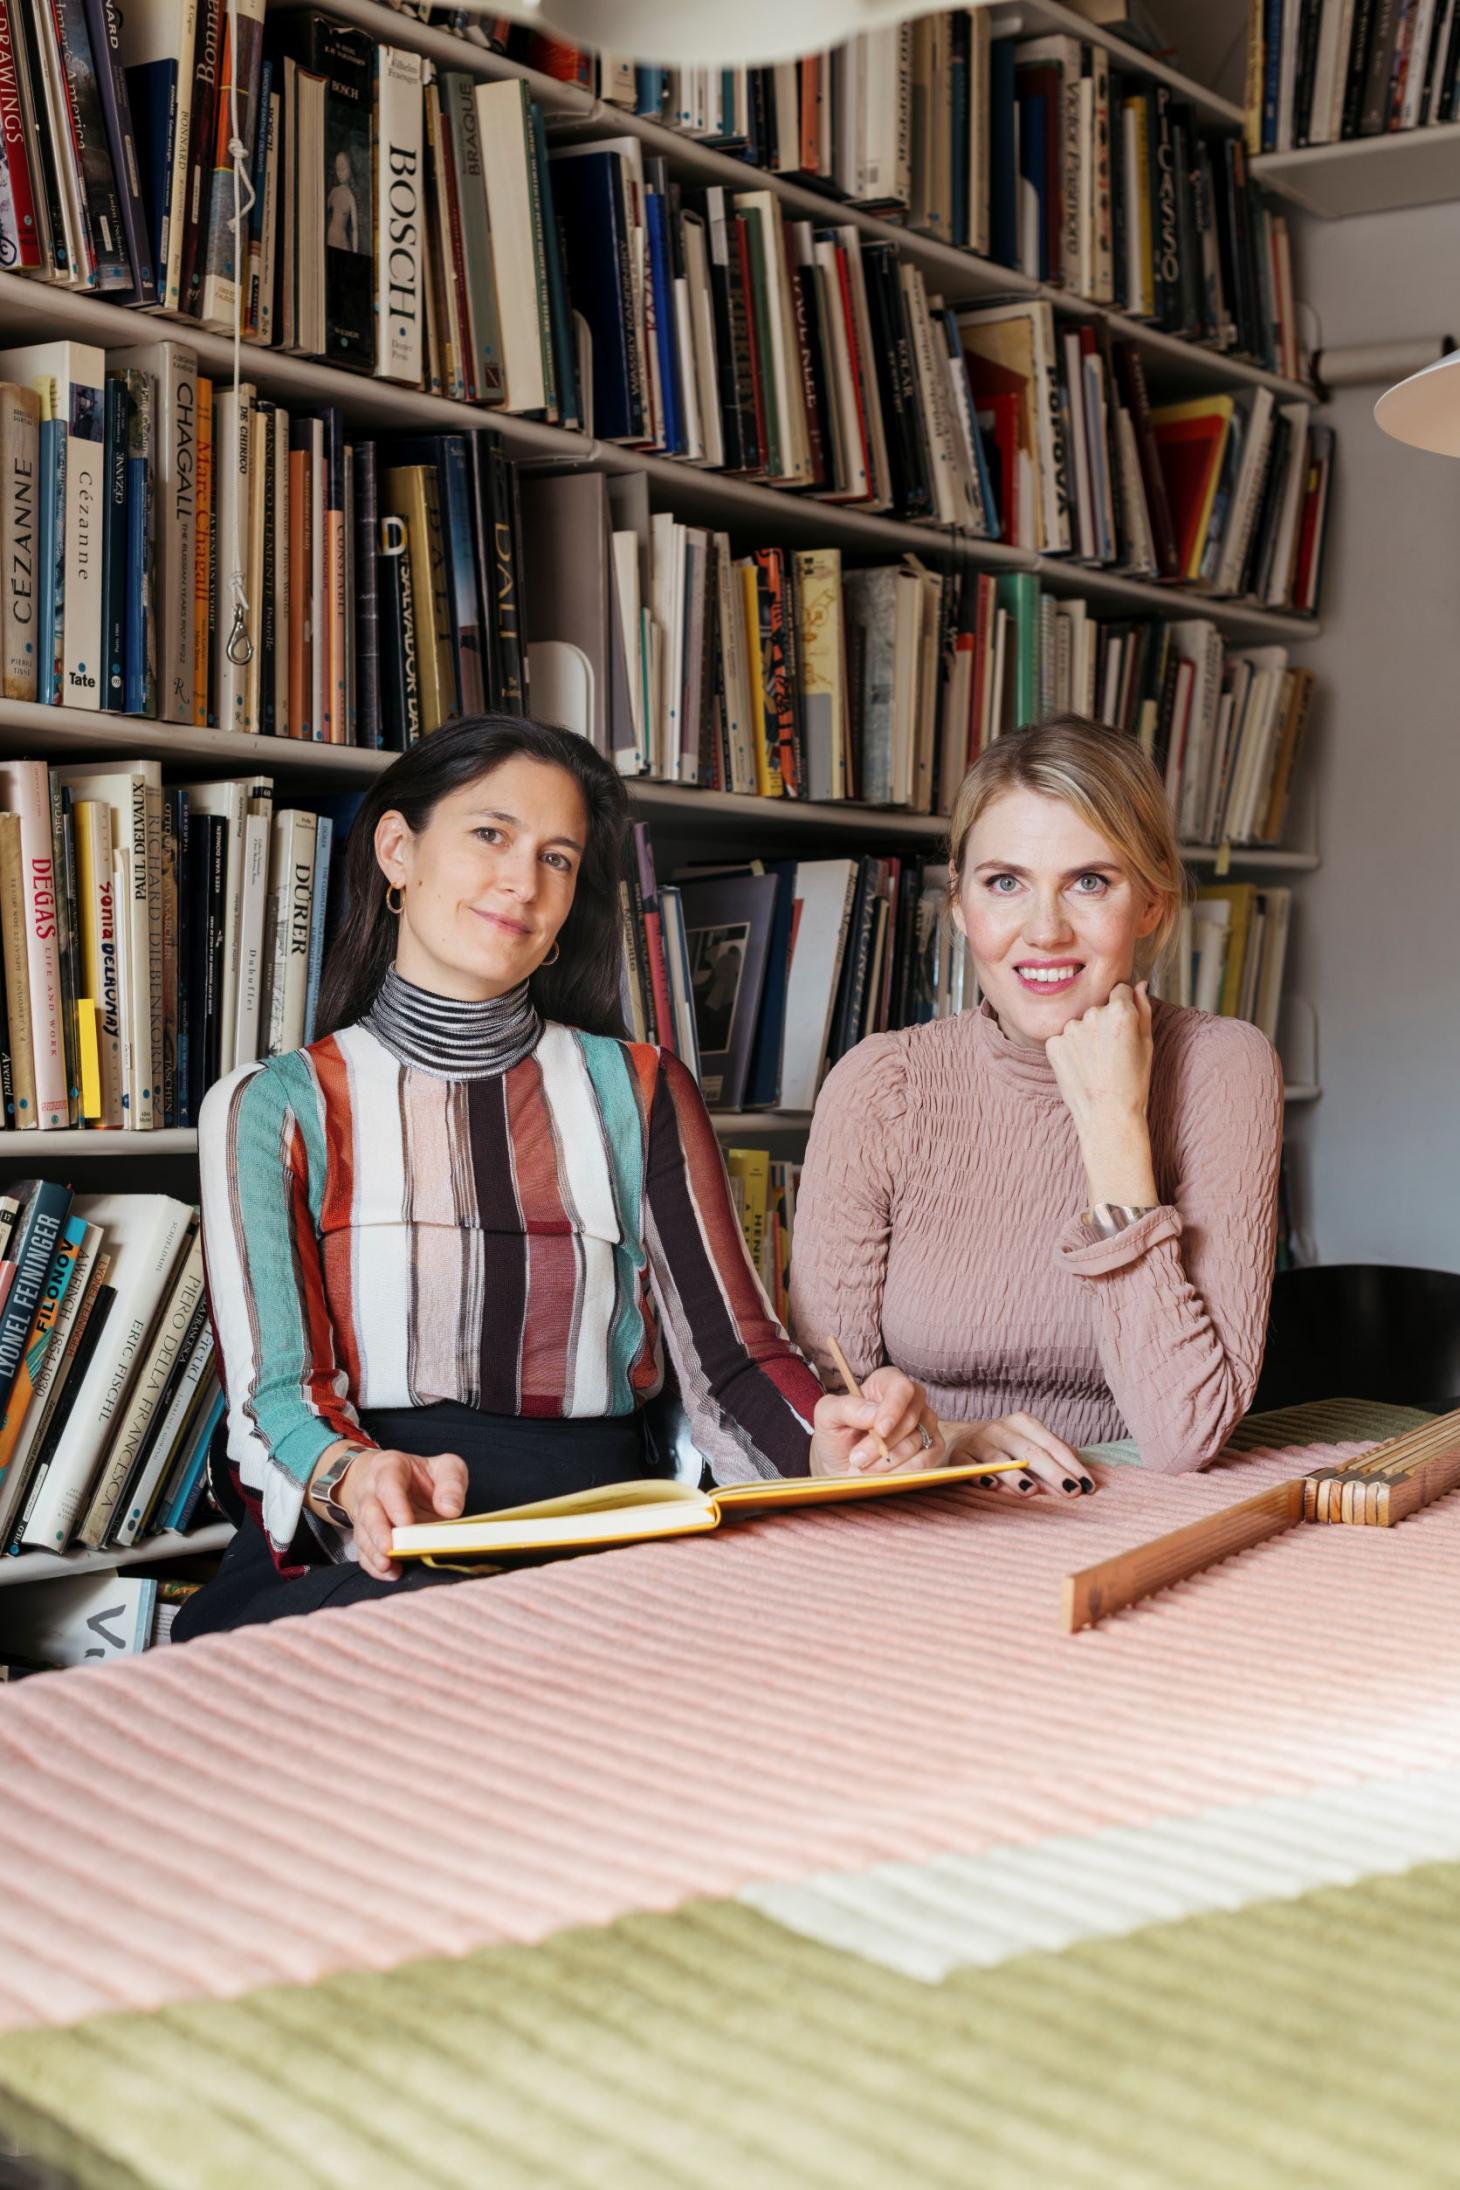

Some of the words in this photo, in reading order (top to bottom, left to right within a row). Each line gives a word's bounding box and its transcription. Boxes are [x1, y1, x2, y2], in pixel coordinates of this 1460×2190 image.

[331, 79, 360, 101] BOSCH
[1065, 81, 1081, 143] Victor
[178, 110, 190, 170] BONNARD
[463, 83, 481, 176] BRAQUE
[1064, 151, 1083, 255] Pasmore
[1154, 87, 1179, 282] PICASSO
[389, 144, 417, 324] BOSCH
[619, 239, 637, 330] KANDINSKY
[628, 332, 637, 394] WASSILY
[239, 405, 249, 422] DE
[114, 451, 125, 504] CÉZANNE
[175, 381, 194, 521] CHAGALL
[196, 439, 212, 487] Marc
[238, 425, 248, 475] CHIRICO
[12, 456, 34, 625] CÉZANNE
[78, 470, 94, 581] Cézanne
[195, 500, 212, 603] Chagall
[265, 507, 275, 598] CLEMENTE
[336, 524, 345, 619] CONSTABLE
[495, 522, 518, 640] DALI
[263, 606, 274, 652] Pastelle
[401, 564, 418, 693] SALVADOR
[69, 671, 96, 689] Tate
[55, 793, 63, 836] DEGAS
[133, 782, 146, 857] DELVAUX
[164, 802, 172, 834] OTTO
[31, 858, 57, 940] DEGAS
[135, 862, 147, 901] PAUL
[148, 814, 162, 922] RICHARD
[291, 863, 312, 956] DÜRER
[45, 946, 53, 977] LIFE
[247, 949, 258, 1013] Dubuffet
[48, 984, 56, 1012] AND
[149, 930, 163, 1075] DIEBENKORN
[50, 1019, 58, 1057] WORK
[2, 1053, 13, 1097] Avenel
[164, 1058, 173, 1113] TASCHEN
[12, 1212, 60, 1309] FEININGER
[35, 1238, 74, 1333] FILONOV
[85, 1260, 109, 1303] LYONEL
[64, 1300, 93, 1358] FEININGER
[170, 1274, 200, 1331] PIERO
[0, 1308, 30, 1378] LYONEL
[33, 1329, 65, 1398] 1854-1930
[121, 1319, 144, 1359] ERIC
[146, 1334, 179, 1391] DELLA
[178, 1313, 204, 1363] FRANCESCA
[97, 1363, 129, 1424] FISCHL
[100, 1397, 154, 1509] FRANCESCA
